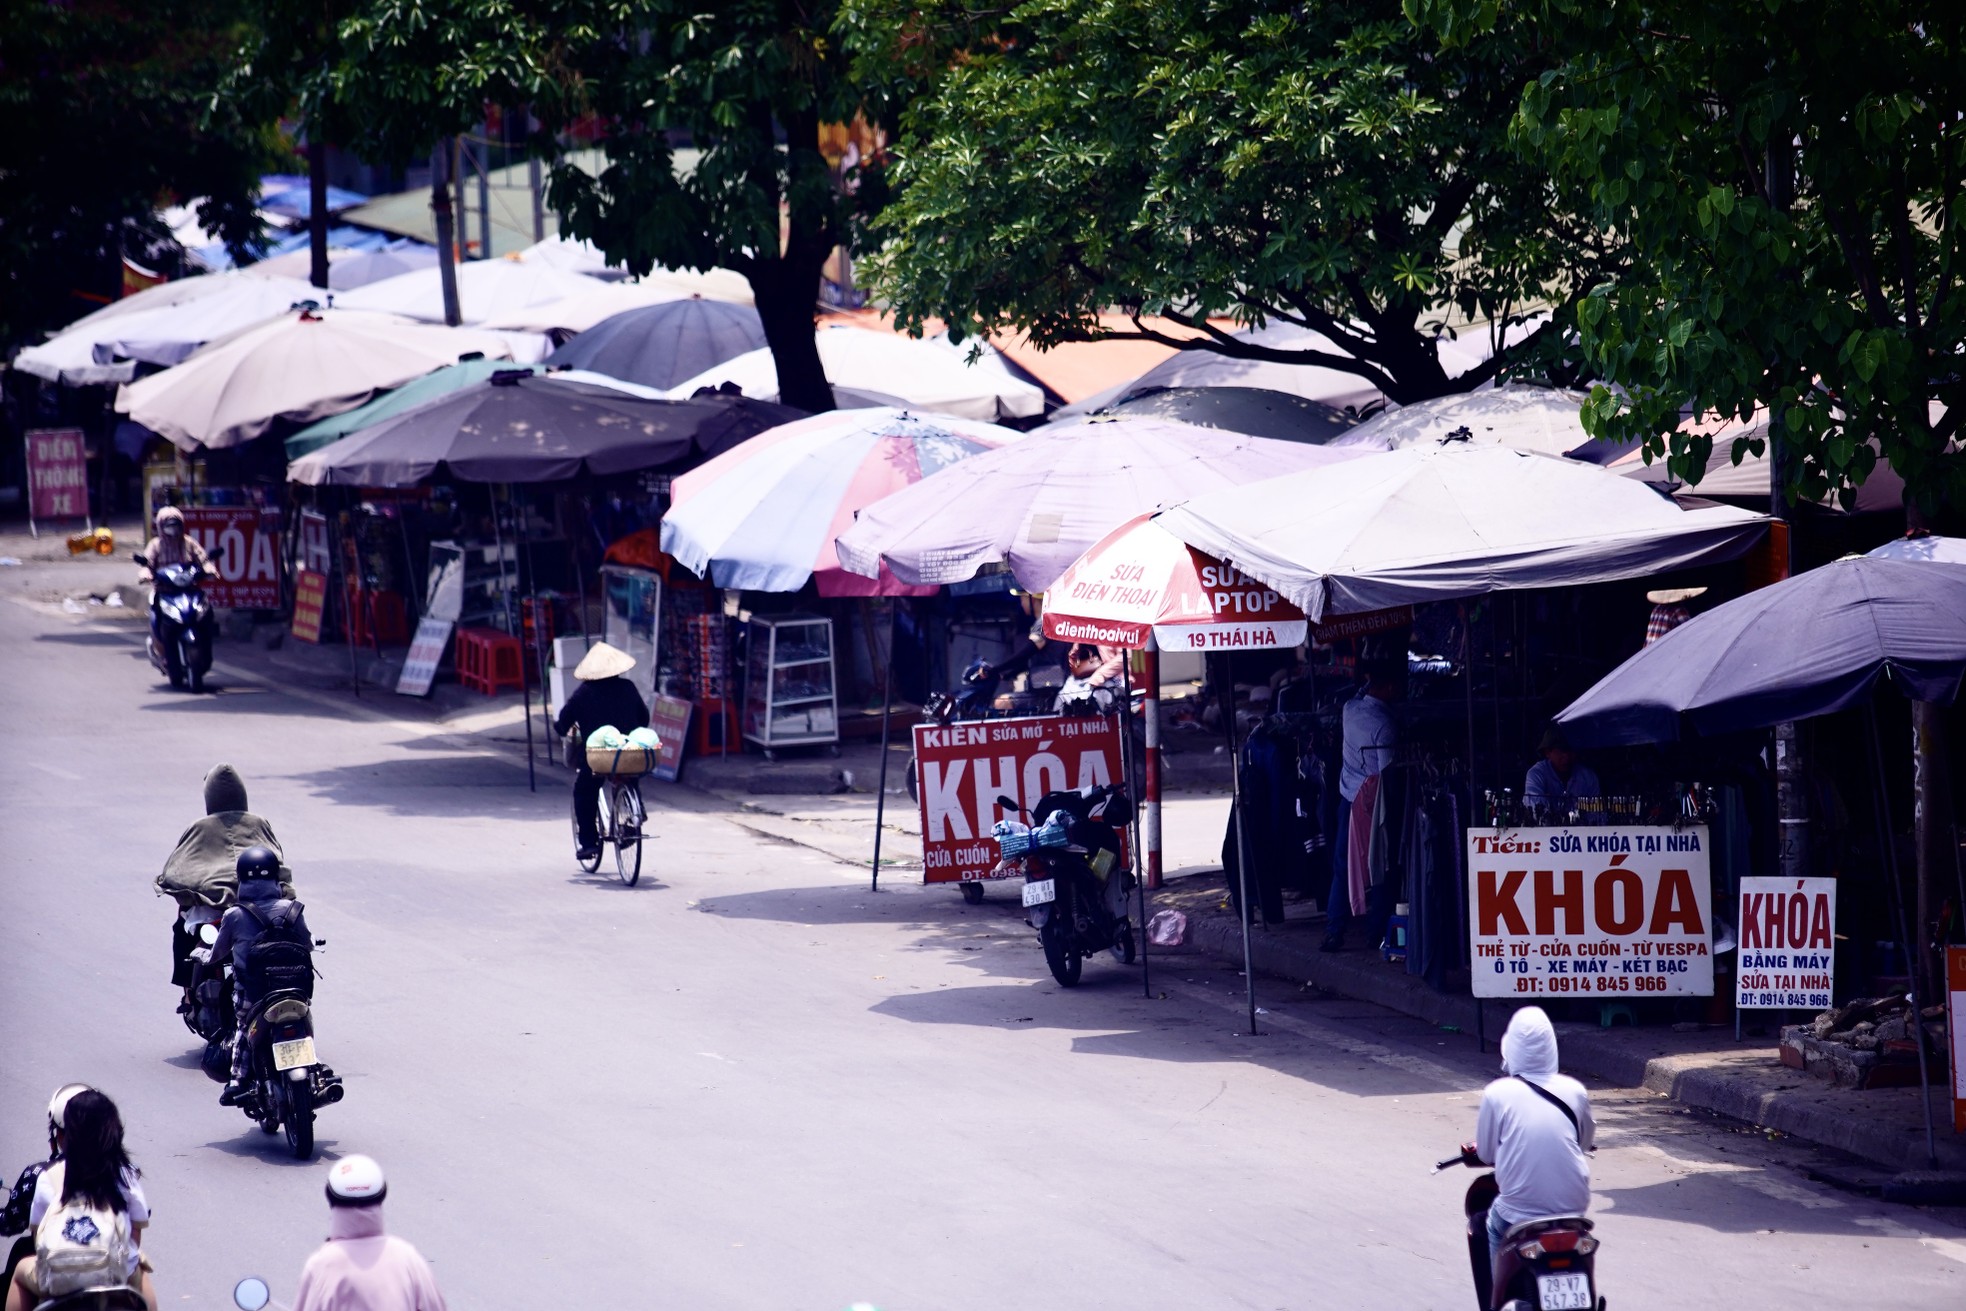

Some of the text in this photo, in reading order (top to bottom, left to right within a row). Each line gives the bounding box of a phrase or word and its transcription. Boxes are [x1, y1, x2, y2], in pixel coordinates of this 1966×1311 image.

[1072, 580, 1158, 608] ĐIỆN THOẠI
[1181, 590, 1278, 614] LAPTOP
[1055, 622, 1139, 644] dienthoaivui
[1188, 626, 1276, 648] 19 THÁI HÀ
[993, 724, 1018, 742] SỬA
[1022, 721, 1043, 738] MỞ
[1058, 724, 1078, 738] TẠI
[1472, 830, 1700, 855] Tiến: SỬA KHÓA TẠI NHÀ
[926, 844, 951, 868] CỬA
[955, 842, 990, 868] CUỐN
[1477, 854, 1705, 936] KHÓA
[1742, 880, 1832, 949] KHÓA
[1477, 939, 1504, 956] THẺ
[1510, 940, 1530, 956] TỪ
[1540, 938, 1572, 956] CỬA
[1578, 939, 1621, 956] CUỐN
[1632, 940, 1653, 956] TỪ
[1656, 943, 1708, 956] VESPA
[1494, 958, 1504, 974] Ô
[1510, 958, 1528, 973] TÔ
[1548, 960, 1567, 973] XE
[1573, 958, 1608, 973] MÁY
[1623, 957, 1650, 972] KÉT
[1656, 959, 1688, 975] BẠC
[1743, 950, 1830, 968] BẰNG MÁY
[1517, 976, 1666, 992] ĐT: 0914 845 966
[1742, 969, 1830, 992] SỬA TẠI NHÀ
[1741, 993, 1828, 1006] ĐT: 0914 845 966
